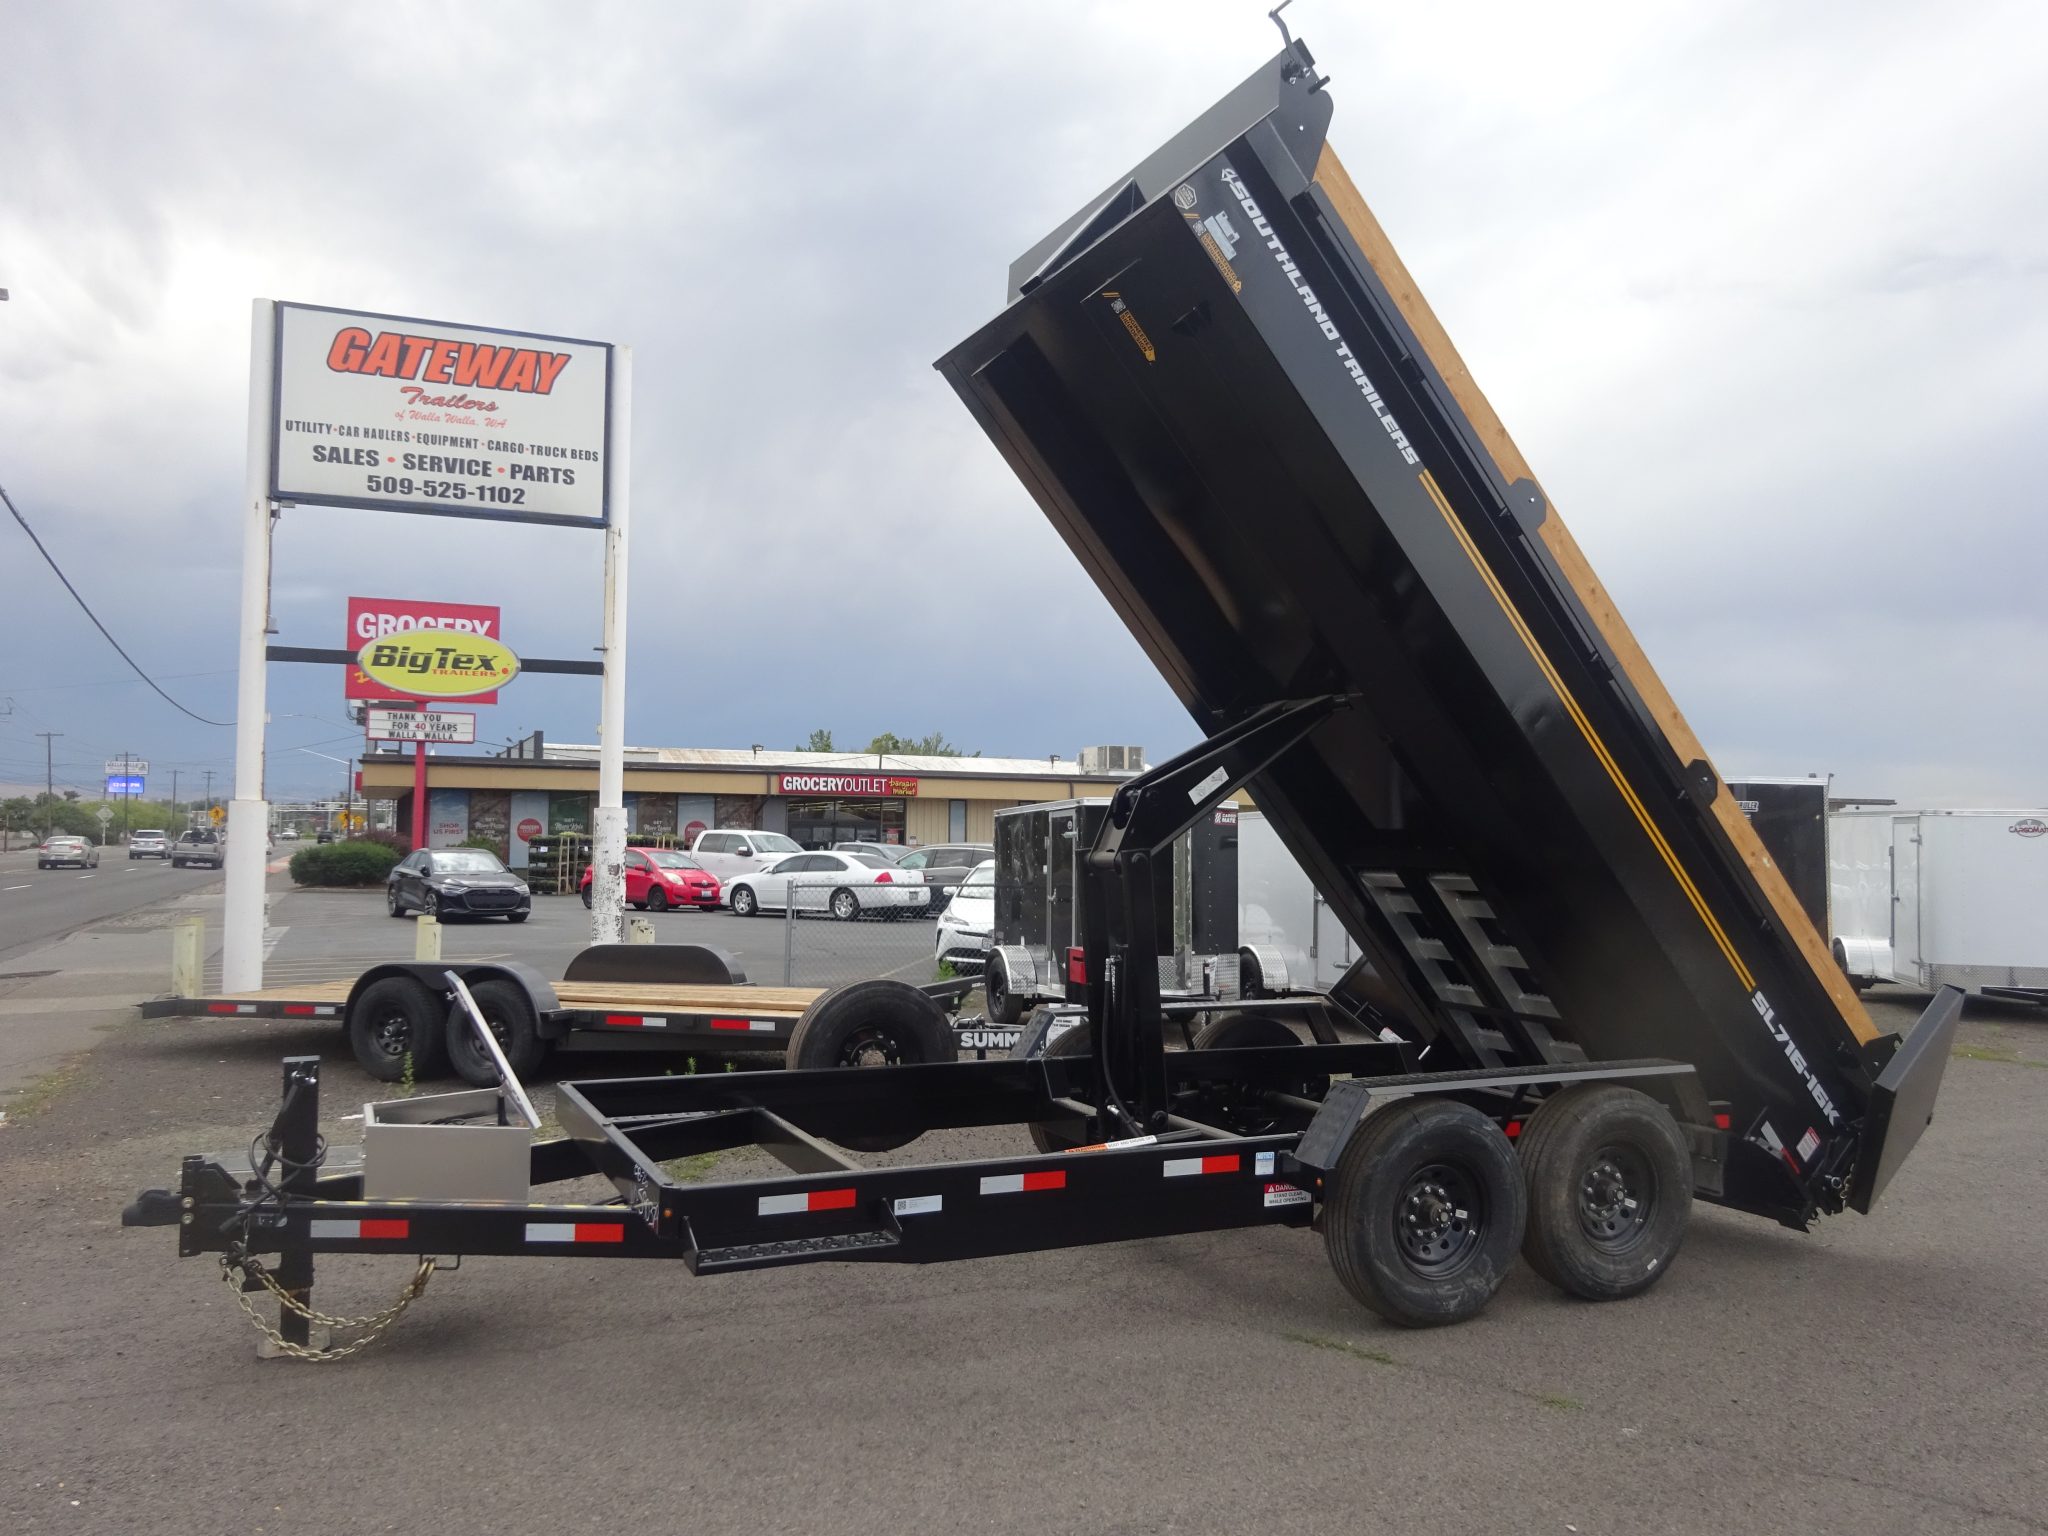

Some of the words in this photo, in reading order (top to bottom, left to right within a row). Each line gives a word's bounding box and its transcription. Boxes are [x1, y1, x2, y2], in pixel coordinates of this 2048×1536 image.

[1229, 181, 1340, 341] SOUTHLAND
[1335, 341, 1420, 465] TRAILERS
[326, 327, 572, 395] GATEWAY
[400, 386, 499, 412] Trailers
[394, 409, 405, 421] of
[408, 410, 441, 423] Walla
[483, 417, 507, 429] WA
[285, 419, 333, 435] UTILITY
[338, 424, 360, 438] CAR
[363, 427, 411, 443] HAULERS
[416, 432, 479, 450] EQUIPMENT
[487, 439, 525, 454] CARGO
[529, 444, 568, 459] TRUCK
[570, 449, 599, 463] BEDS
[312, 444, 380, 467] SALES
[402, 452, 492, 478] SERVICE
[510, 463, 576, 486] PARTS
[366, 475, 526, 505] 509-525-1102
[371, 645, 499, 674] BigTex
[431, 668, 498, 678] TRAILERS
[387, 712, 416, 721] THANK
[423, 713, 442, 722] YOU
[392, 722, 410, 730] FOR
[415, 723, 426, 731] 40
[430, 724, 458, 732] YEARS
[388, 731, 417, 739] WALLA
[424, 732, 454, 741] WALLA
[889, 777, 917, 790] bargain
[960, 1032, 1021, 1048] SUMM
[1751, 991, 1840, 1126] SL716-16K
[1275, 1184, 1297, 1192] DANG
